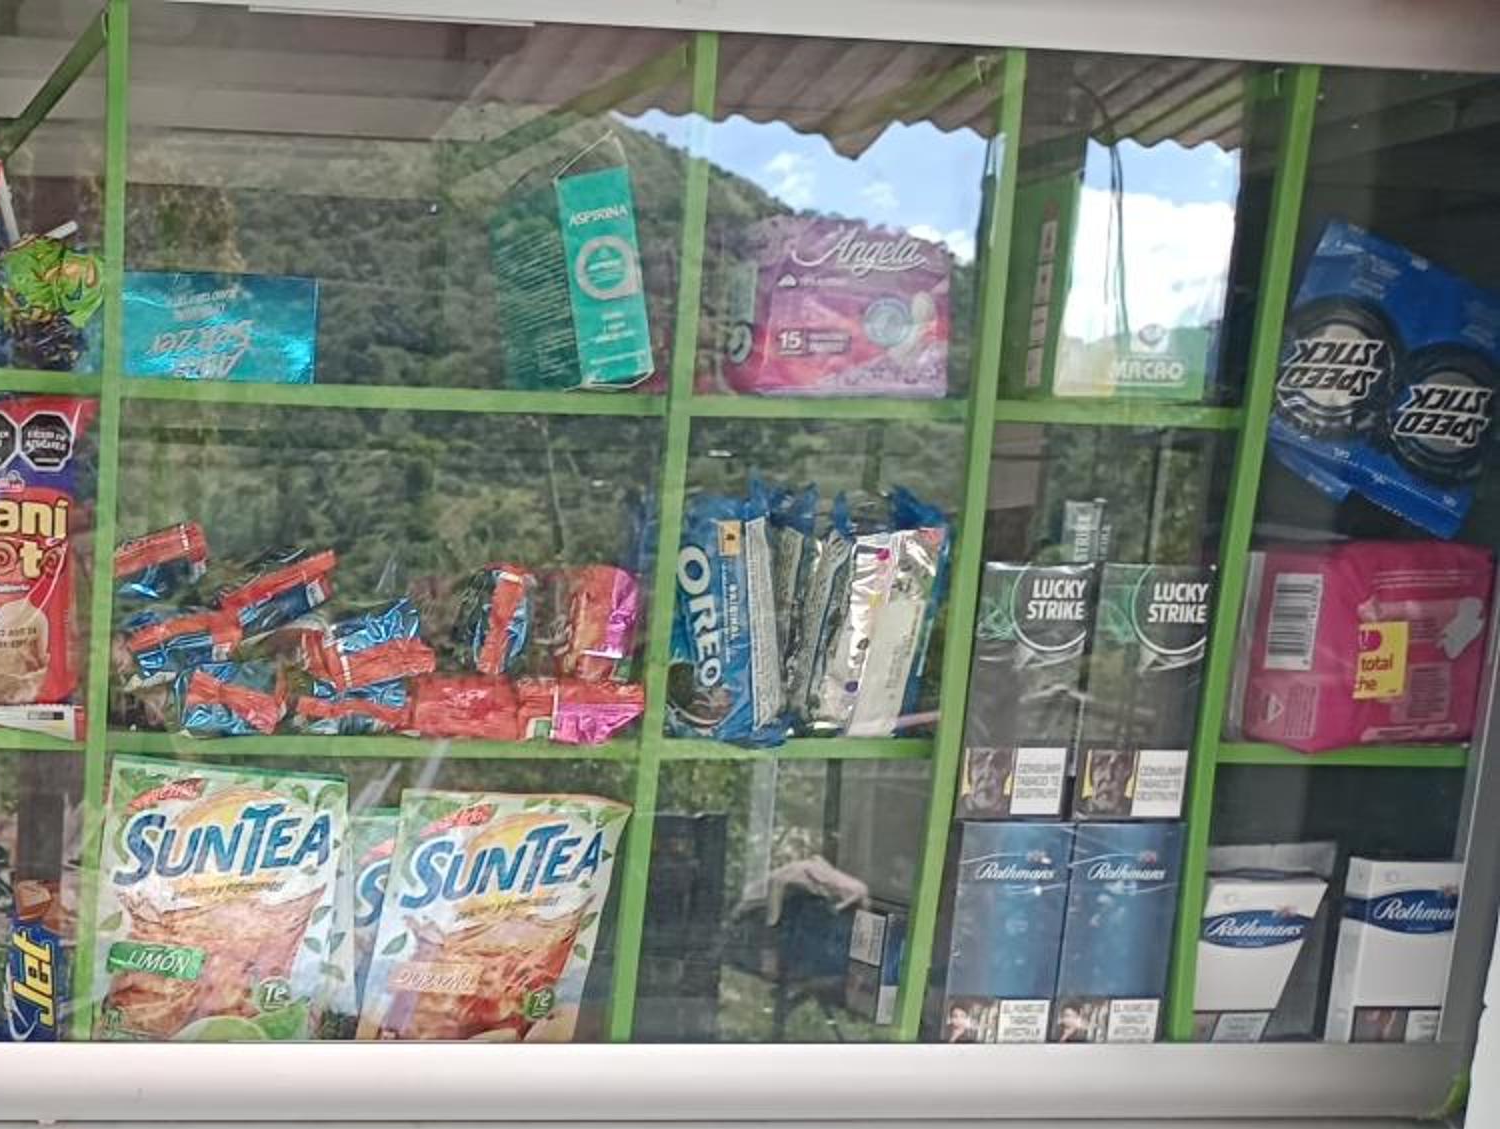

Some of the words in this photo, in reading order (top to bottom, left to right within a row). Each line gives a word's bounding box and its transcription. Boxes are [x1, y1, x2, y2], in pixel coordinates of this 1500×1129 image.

[569, 205, 629, 227] ASPIRINA
[791, 226, 928, 279] Angela
[778, 331, 802, 349] 15
[1292, 341, 1381, 366] STICK
[1283, 368, 1379, 397] SPEED
[1406, 386, 1491, 414] STICK
[1397, 411, 1488, 446] SPEED
[1032, 579, 1088, 599] LUCKY
[1153, 583, 1210, 603] LUCKY
[677, 545, 722, 687] OREO
[728, 583, 740, 641] ORIGINAL
[1026, 600, 1086, 620] STRIKE
[1148, 604, 1208, 624] STRIKE
[1361, 653, 1394, 672] total
[975, 863, 1056, 882] Rothmans
[1087, 863, 1167, 882] Rothmans
[1206, 918, 1305, 937] Rothmans
